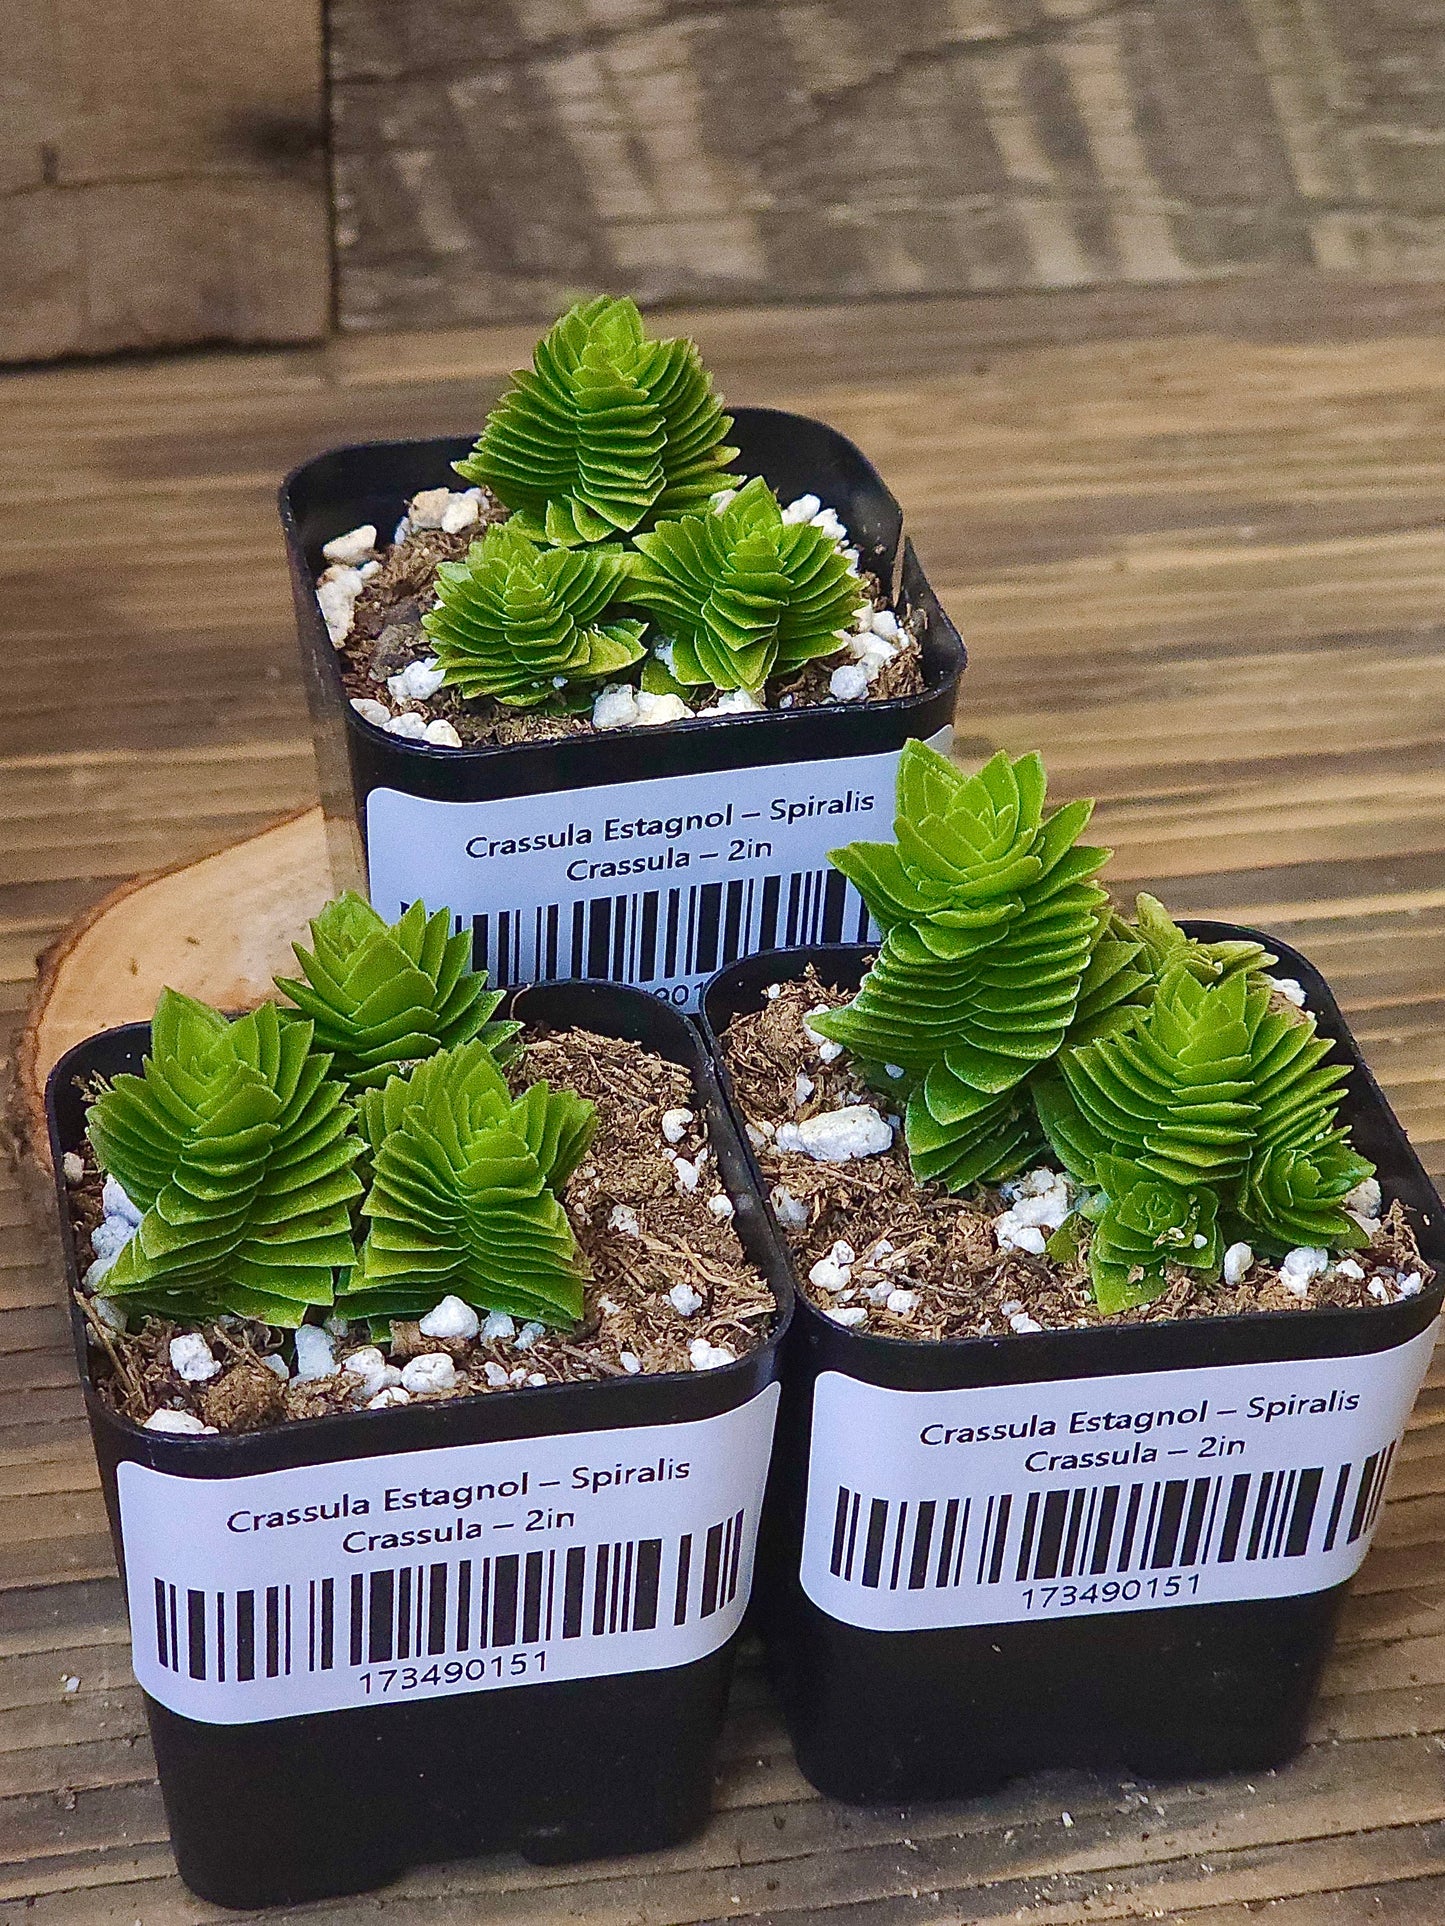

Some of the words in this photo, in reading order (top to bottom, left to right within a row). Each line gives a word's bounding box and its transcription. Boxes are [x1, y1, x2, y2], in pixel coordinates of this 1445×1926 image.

[466, 823, 591, 858] Crassula
[604, 804, 733, 842] Estagnol
[770, 791, 874, 825] Spiralis
[567, 847, 689, 881] Crassula
[728, 839, 771, 861] 2in
[920, 1415, 1056, 1446] Crassula
[1070, 1400, 1208, 1434] Estagnol
[1247, 1390, 1360, 1424] Spiralis
[1025, 1442, 1157, 1472] Crassula
[1198, 1436, 1245, 1457] 2in
[227, 1494, 369, 1533] Crassula
[385, 1472, 528, 1511] Estagnol
[572, 1458, 690, 1493] Spiralis
[343, 1518, 481, 1553] Crassula
[526, 1508, 574, 1531] 2in
[1023, 1574, 1199, 1609] 173490151
[360, 1651, 548, 1695] 173490151
